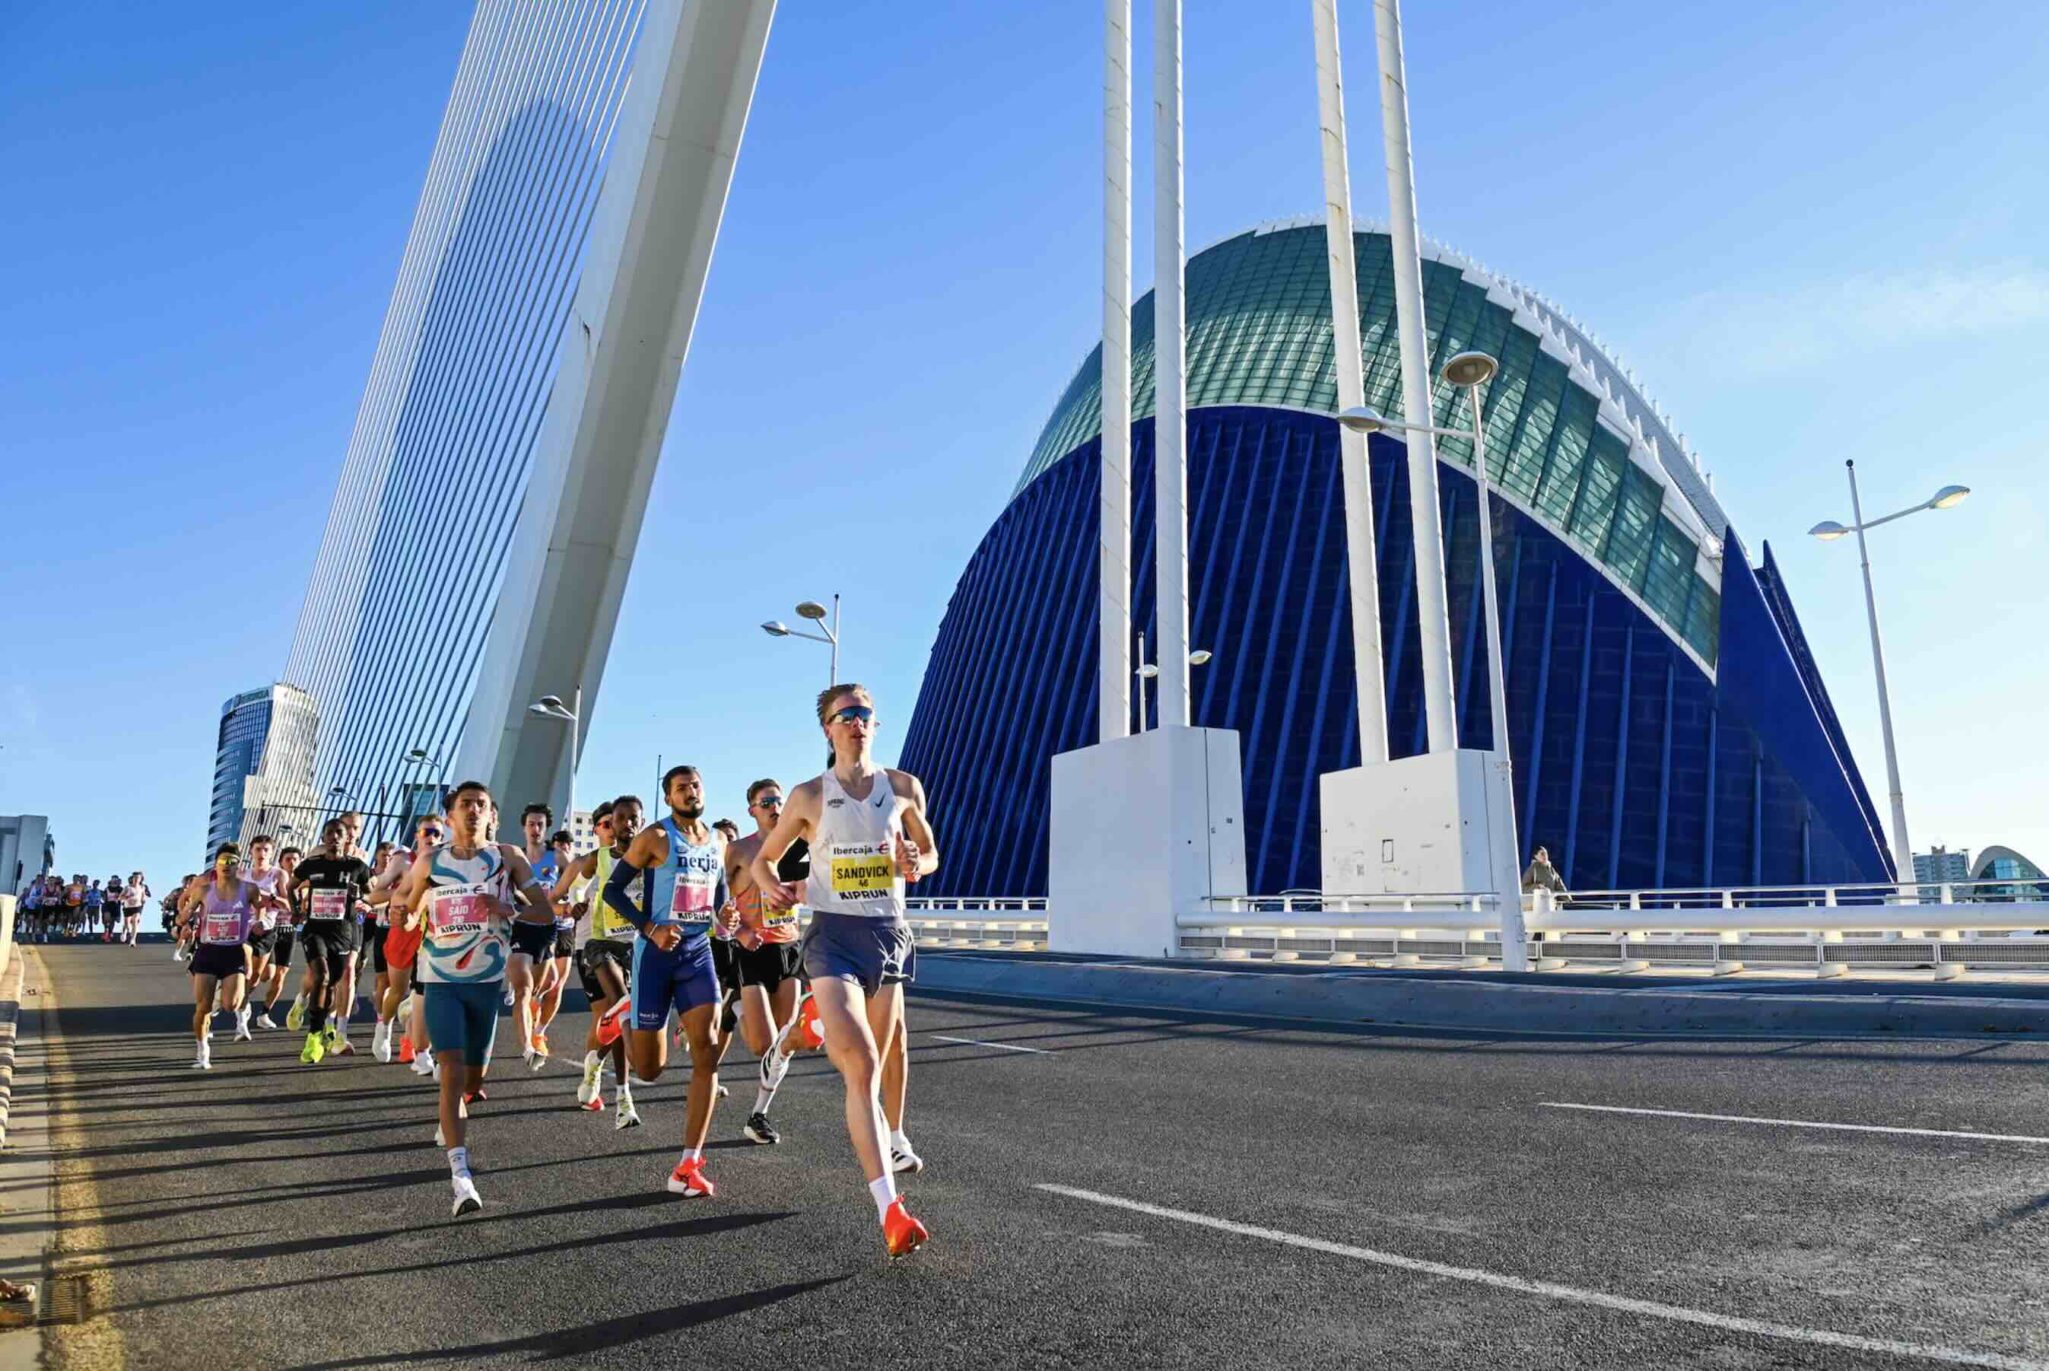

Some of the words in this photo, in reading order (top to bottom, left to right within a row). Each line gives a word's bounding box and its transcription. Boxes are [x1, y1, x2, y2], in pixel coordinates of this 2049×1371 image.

[833, 846, 872, 855] Ibercaja
[677, 854, 718, 873] nerja
[836, 866, 889, 879] SANDVICK
[839, 889, 888, 900] KIPRUN
[448, 905, 469, 917] SAID
